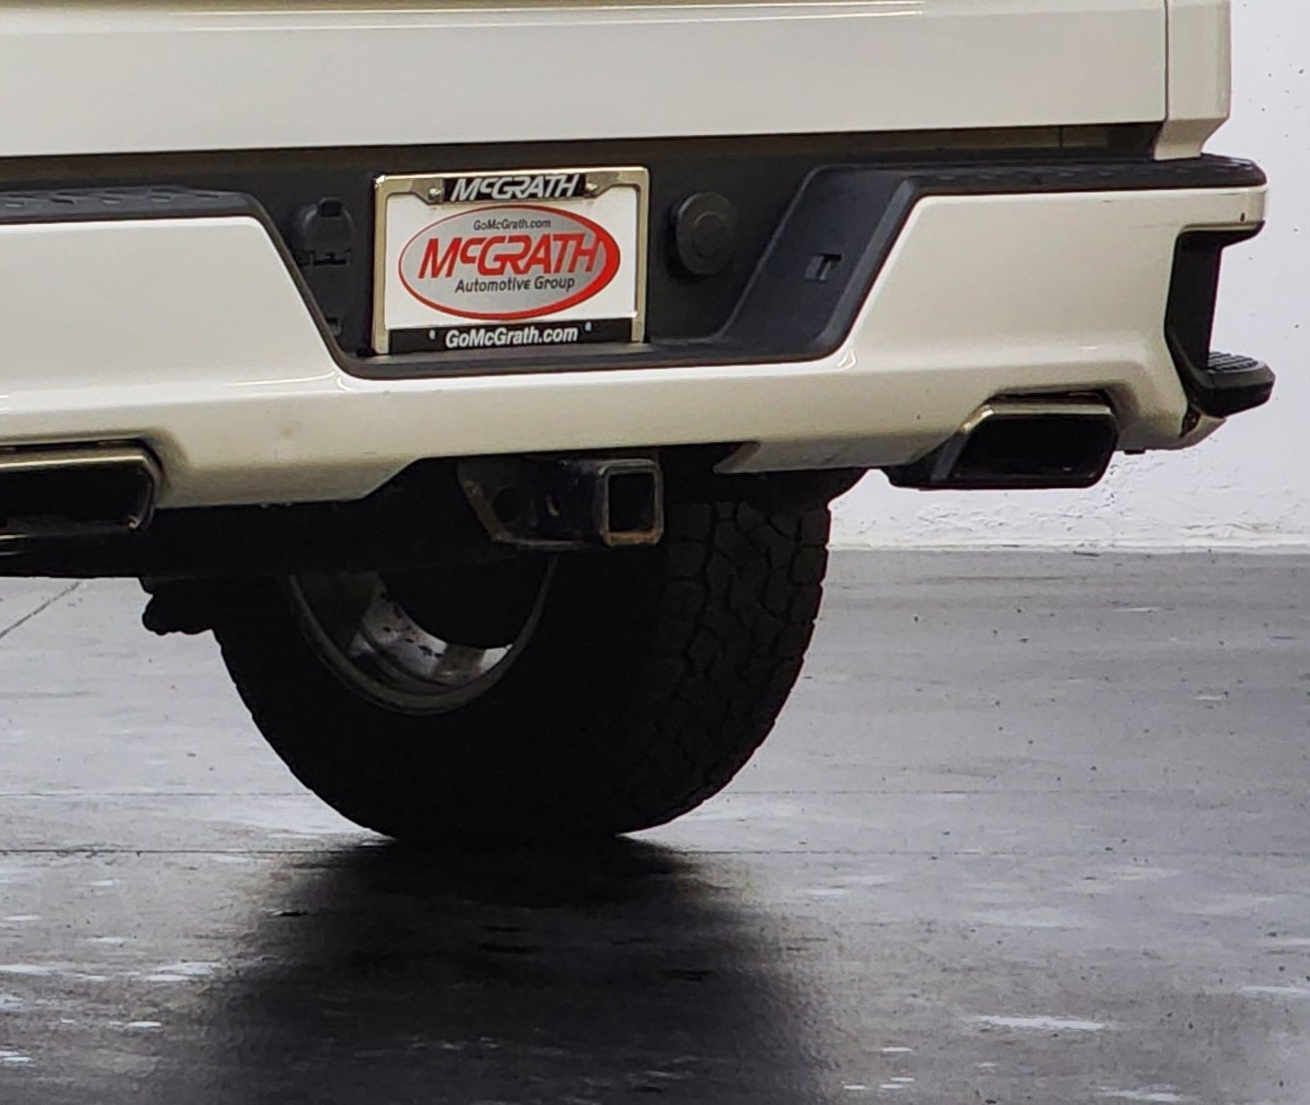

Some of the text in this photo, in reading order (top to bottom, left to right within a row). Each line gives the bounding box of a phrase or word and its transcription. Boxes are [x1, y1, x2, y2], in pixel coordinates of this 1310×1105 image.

[450, 174, 580, 201] McGRATH
[473, 218, 551, 231] GoMcGrath.com
[418, 232, 602, 279] McGRATH
[454, 276, 575, 294] Automotive Group
[445, 326, 579, 349] GoMcGrath.com
